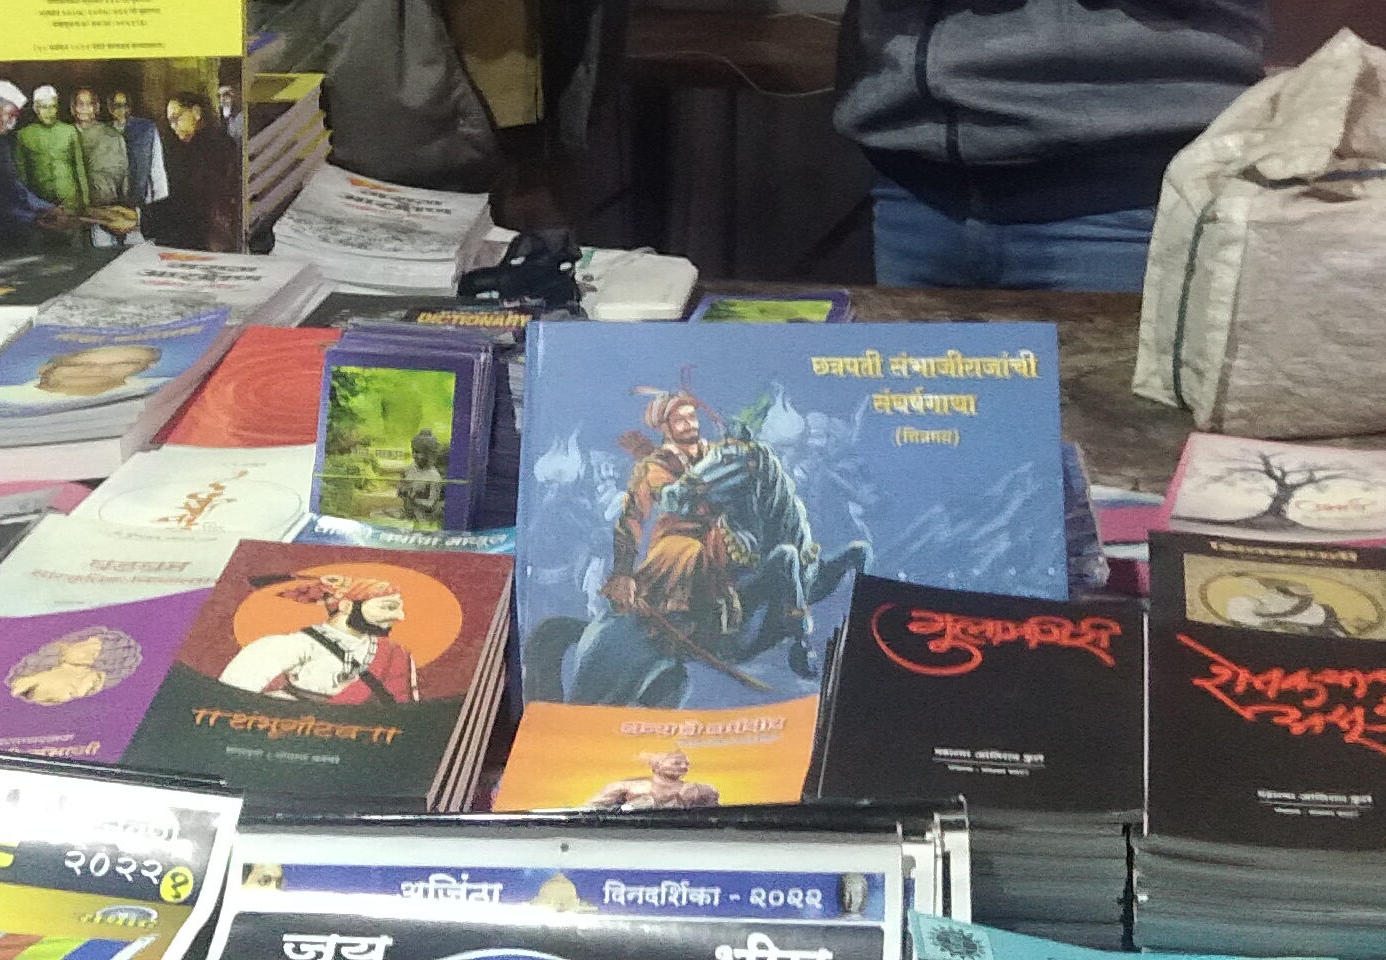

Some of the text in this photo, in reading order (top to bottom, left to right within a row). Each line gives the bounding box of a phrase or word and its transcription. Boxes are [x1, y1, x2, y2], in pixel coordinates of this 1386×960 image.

[811, 348, 1041, 379] छत्रपती संभाजीराजांची
[64, 850, 163, 886] २०२२
[603, 878, 722, 908] दिनदर्शिका
[748, 887, 824, 910] २०२२
